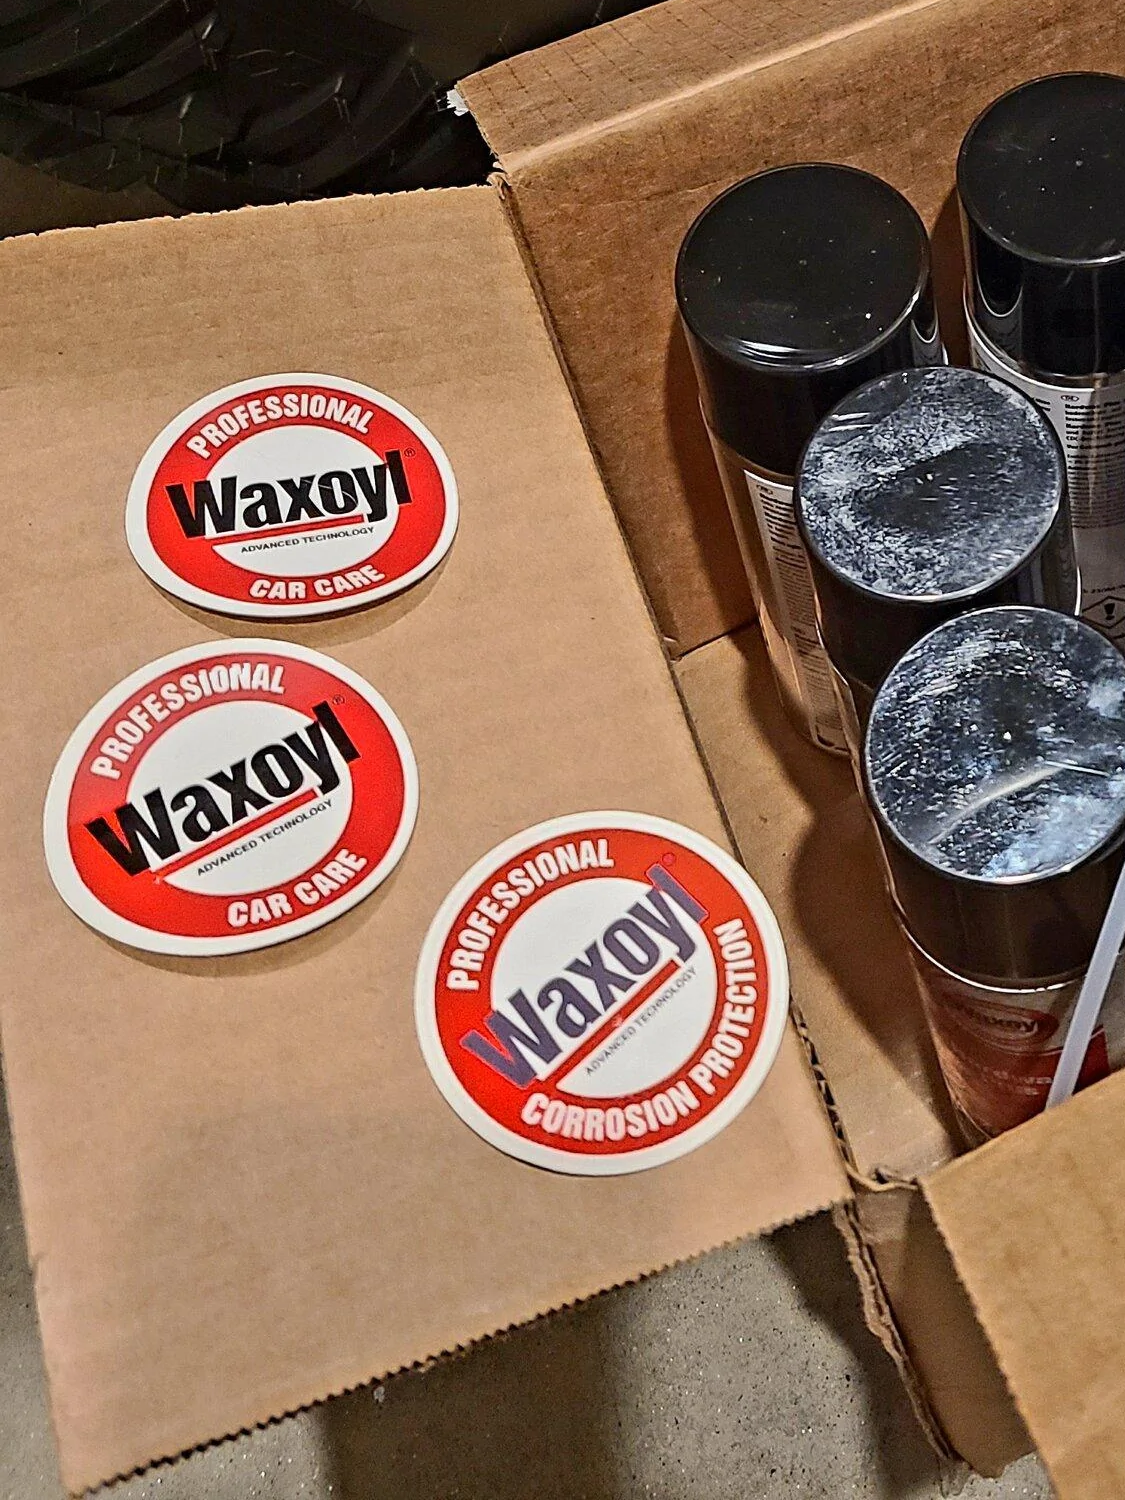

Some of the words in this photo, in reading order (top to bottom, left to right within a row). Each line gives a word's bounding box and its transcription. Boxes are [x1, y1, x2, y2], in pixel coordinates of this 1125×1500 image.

[186, 393, 374, 459] PROFESSIONAL
[240, 537, 300, 554] ADVANCED
[302, 526, 375, 545] TECHNOLOGY
[249, 579, 306, 600] CAR
[315, 564, 386, 596] CARE
[90, 663, 286, 780] PROFESSIONAL
[197, 840, 258, 876] ADVANCED
[259, 799, 333, 846] TECHNOLOGY
[226, 892, 293, 928] CAR
[293, 848, 368, 906] CARE
[446, 838, 616, 991] PROFESSIONAL
[521, 1082, 701, 1142] CORROSION
[689, 917, 758, 1096] PROTECTION
[583, 1026, 637, 1077] ADVANCED
[635, 965, 698, 1031] TECHNOLOGY
